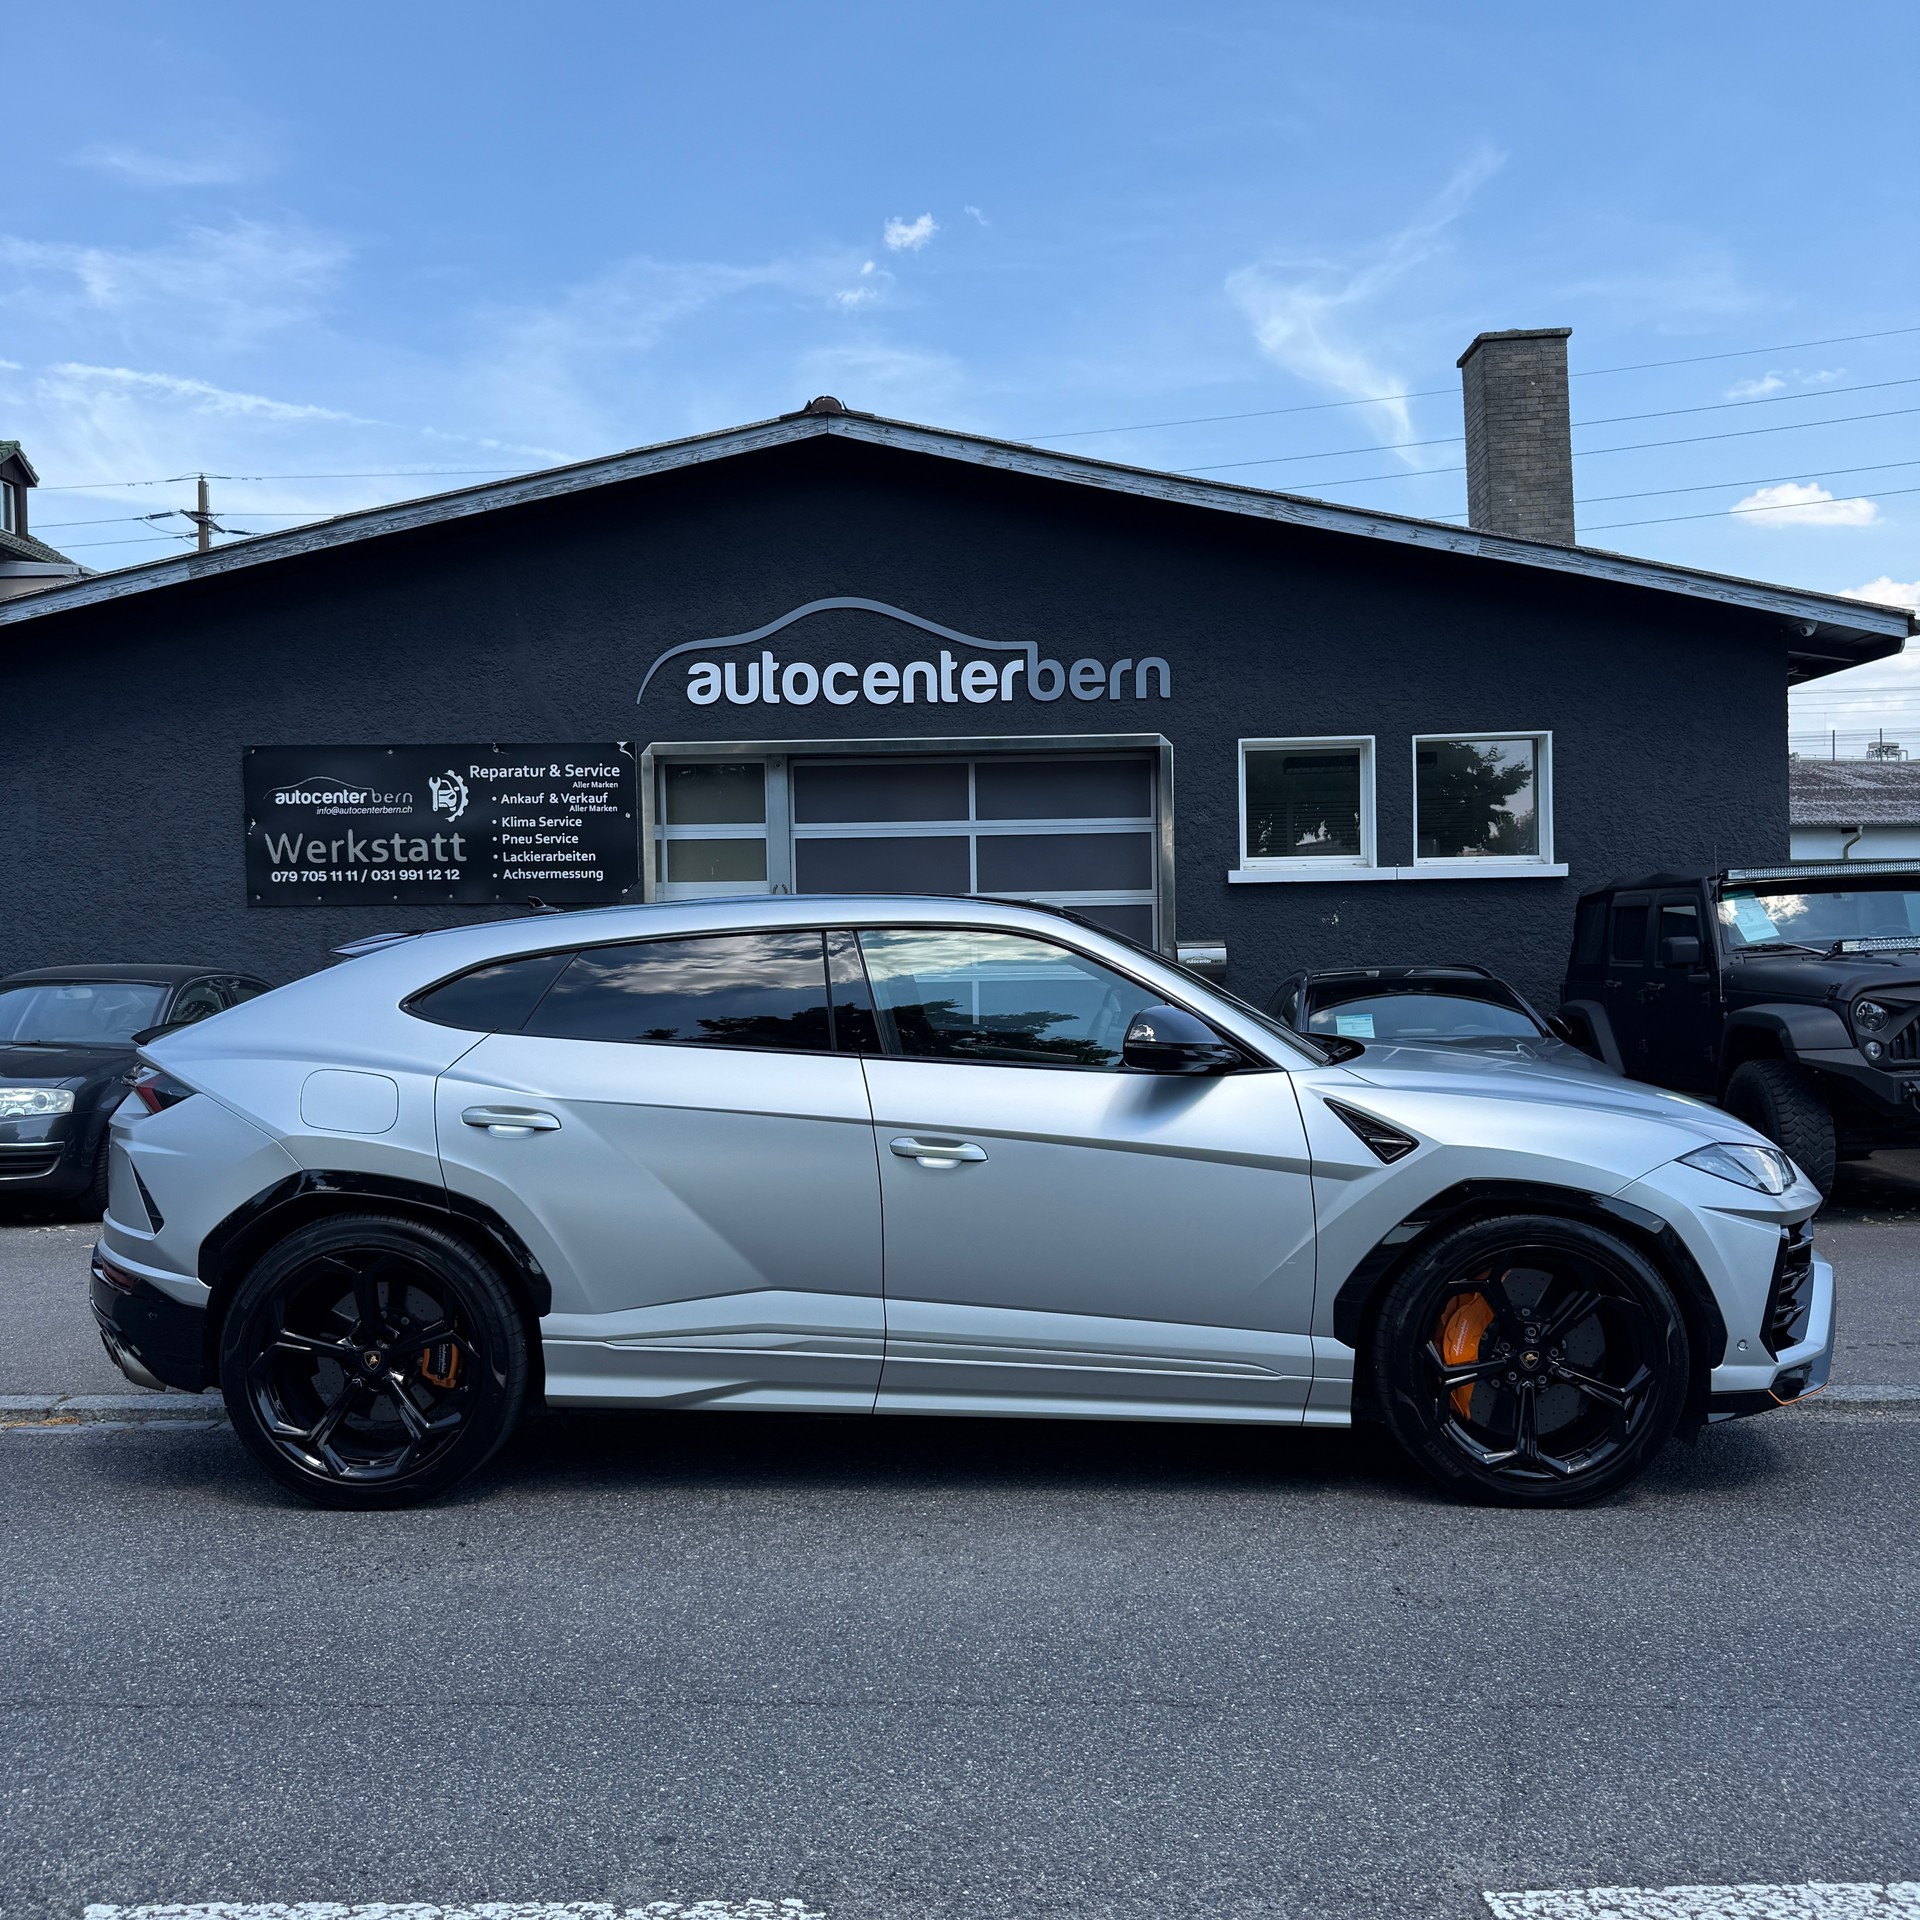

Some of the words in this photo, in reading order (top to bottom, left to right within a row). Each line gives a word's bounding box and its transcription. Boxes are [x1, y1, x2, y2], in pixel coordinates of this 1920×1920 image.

[470, 766, 546, 781] Reparatur
[550, 765, 560, 777] &
[565, 763, 620, 777] Service
[573, 781, 590, 789] Aller
[592, 781, 619, 789] Marken
[501, 793, 544, 804] Ankauf
[550, 793, 558, 803] &
[561, 792, 608, 803] Verkauf
[316, 806, 413, 815] info@autocenterbern.ch
[570, 804, 588, 812] Aller
[589, 804, 618, 812] Marken
[502, 816, 535, 827] Klima
[539, 816, 582, 827] Service
[503, 834, 532, 844] Pneu
[536, 833, 578, 844] Service
[265, 829, 466, 864] Werkstatt
[503, 851, 596, 862] Lackierarbeiten
[272, 871, 297, 882] 079
[301, 871, 327, 881] 705
[330, 871, 342, 881] 11
[346, 871, 357, 881] 11
[360, 869, 368, 883] /
[371, 870, 395, 880] 031
[399, 870, 423, 880] 991
[427, 869, 441, 880] 12
[445, 869, 459, 879] 12
[503, 868, 603, 881] Achsvermessung
